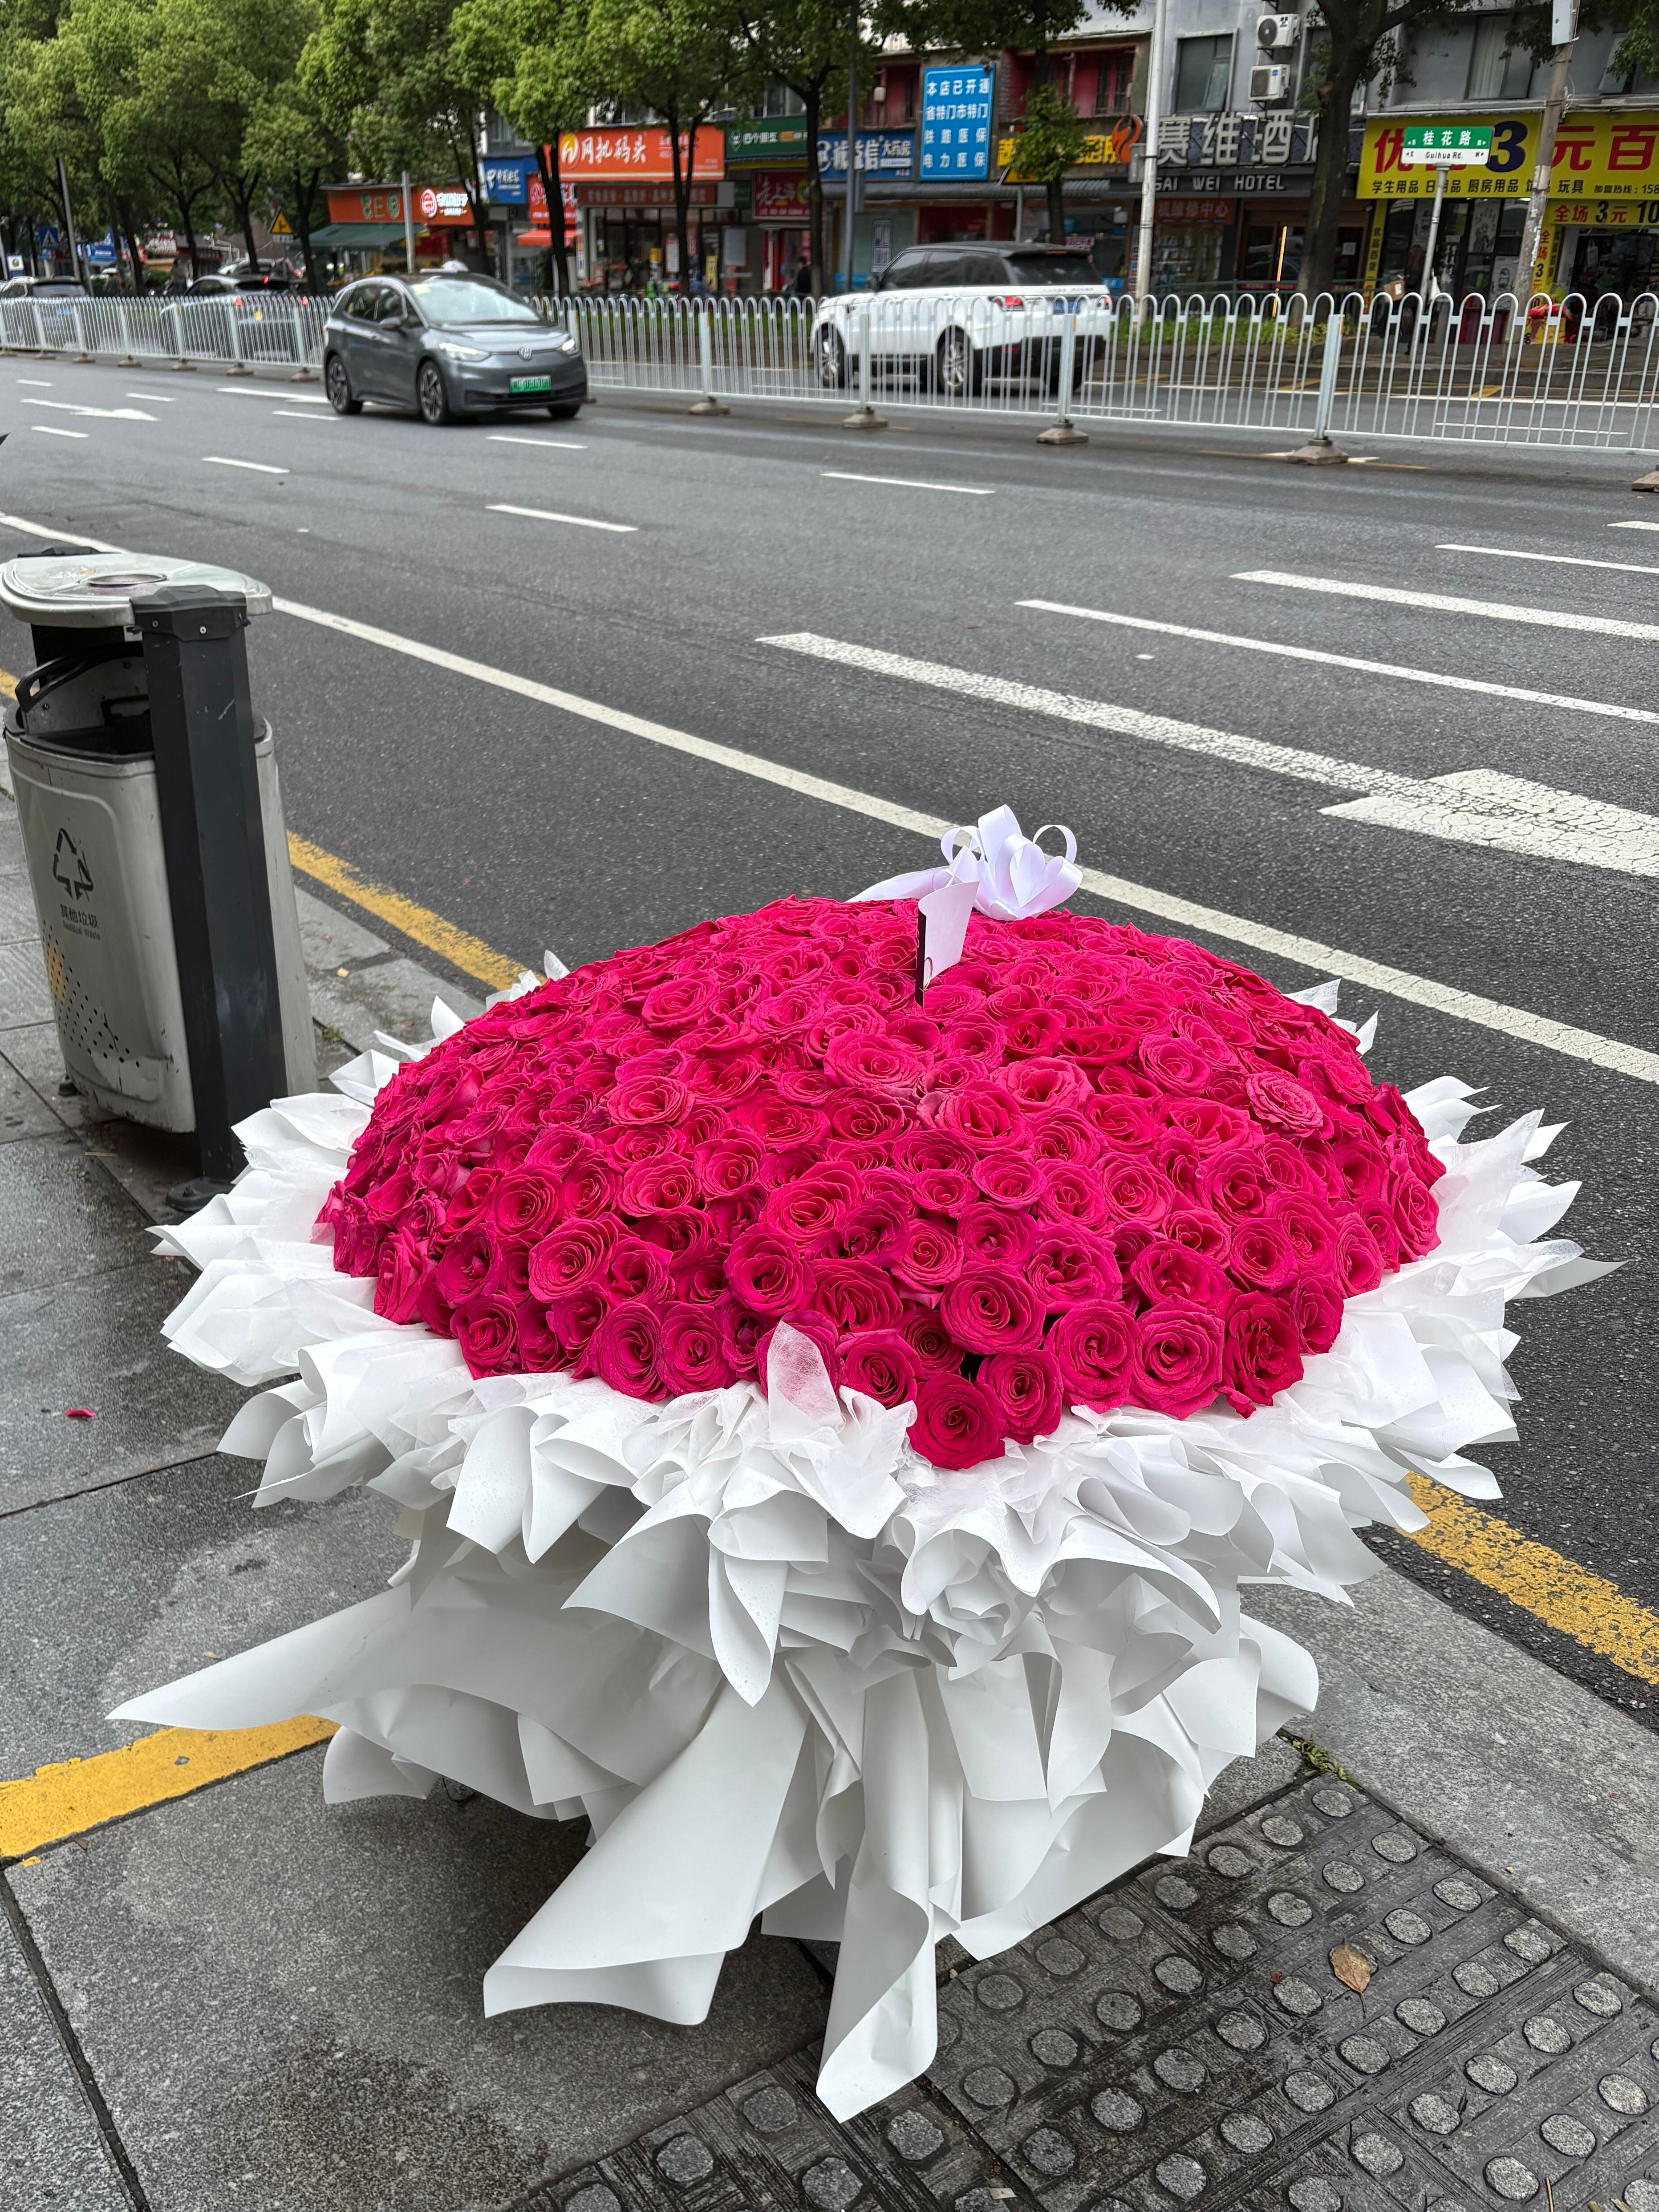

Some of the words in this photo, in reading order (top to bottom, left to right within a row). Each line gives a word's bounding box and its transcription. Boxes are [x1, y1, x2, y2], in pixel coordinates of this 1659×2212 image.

[926, 78, 990, 97] 本店已开通
[1423, 130, 1471, 146] 桂花路
[923, 152, 986, 169] 电力医保
[1155, 177, 1178, 191] SAI
[1193, 176, 1220, 191] WEI
[1234, 175, 1285, 190] HOTEL
[1372, 180, 1419, 194] 学生用品
[1468, 179, 1518, 193] 厨房用品
[1558, 180, 1584, 193] 玩具
[60, 904, 99, 929] 其他垃圾
